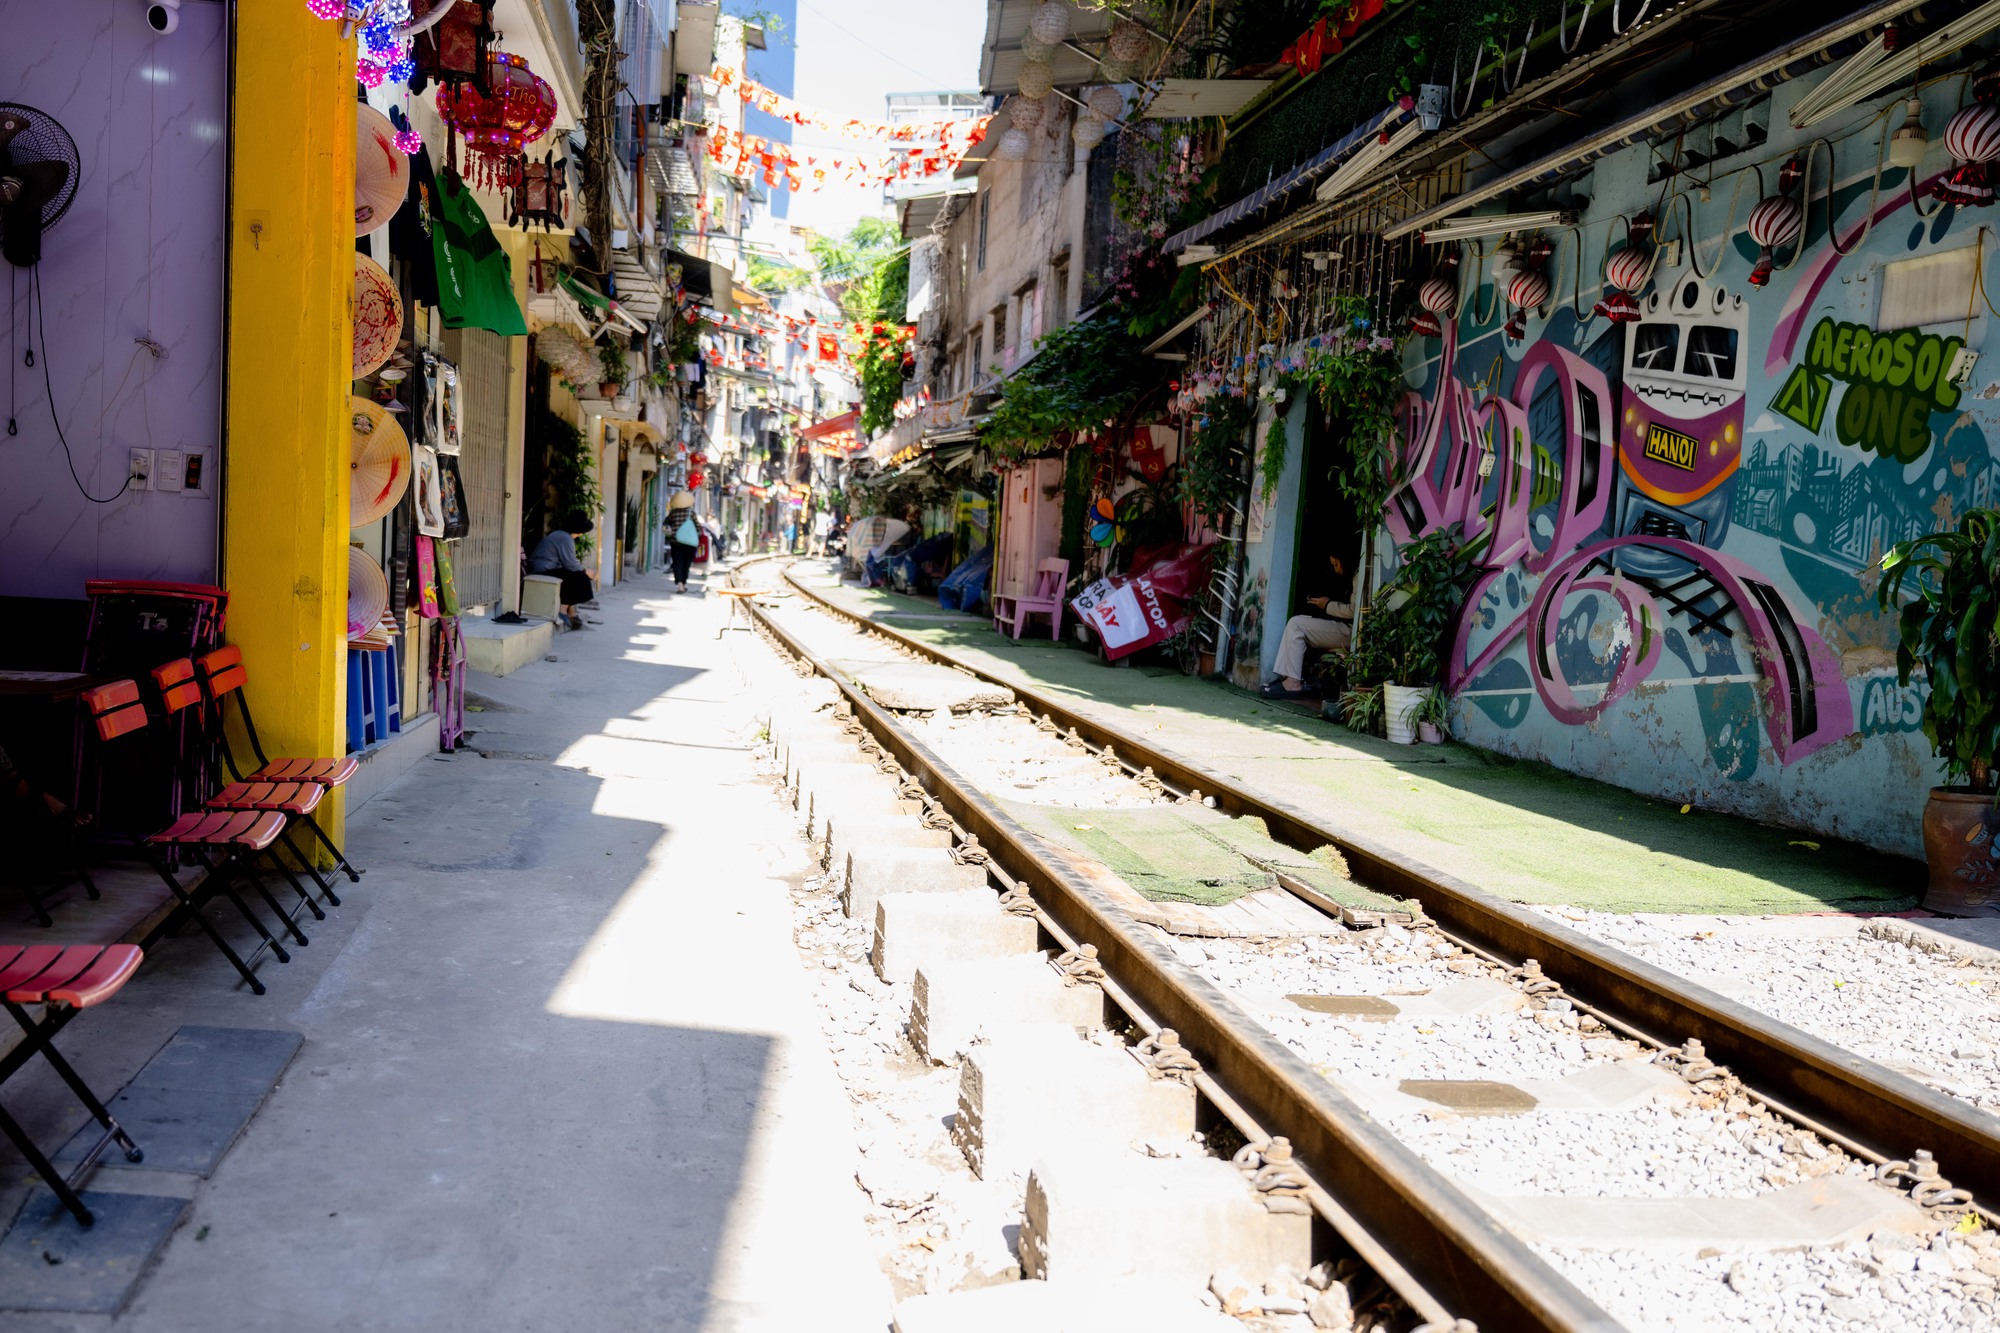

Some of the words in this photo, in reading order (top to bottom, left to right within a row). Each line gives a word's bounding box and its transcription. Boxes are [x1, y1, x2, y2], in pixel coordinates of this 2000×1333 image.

[1807, 318, 1962, 411] AEROSOL
[1649, 429, 1695, 467] HANOI
[1841, 382, 1930, 460] ONE
